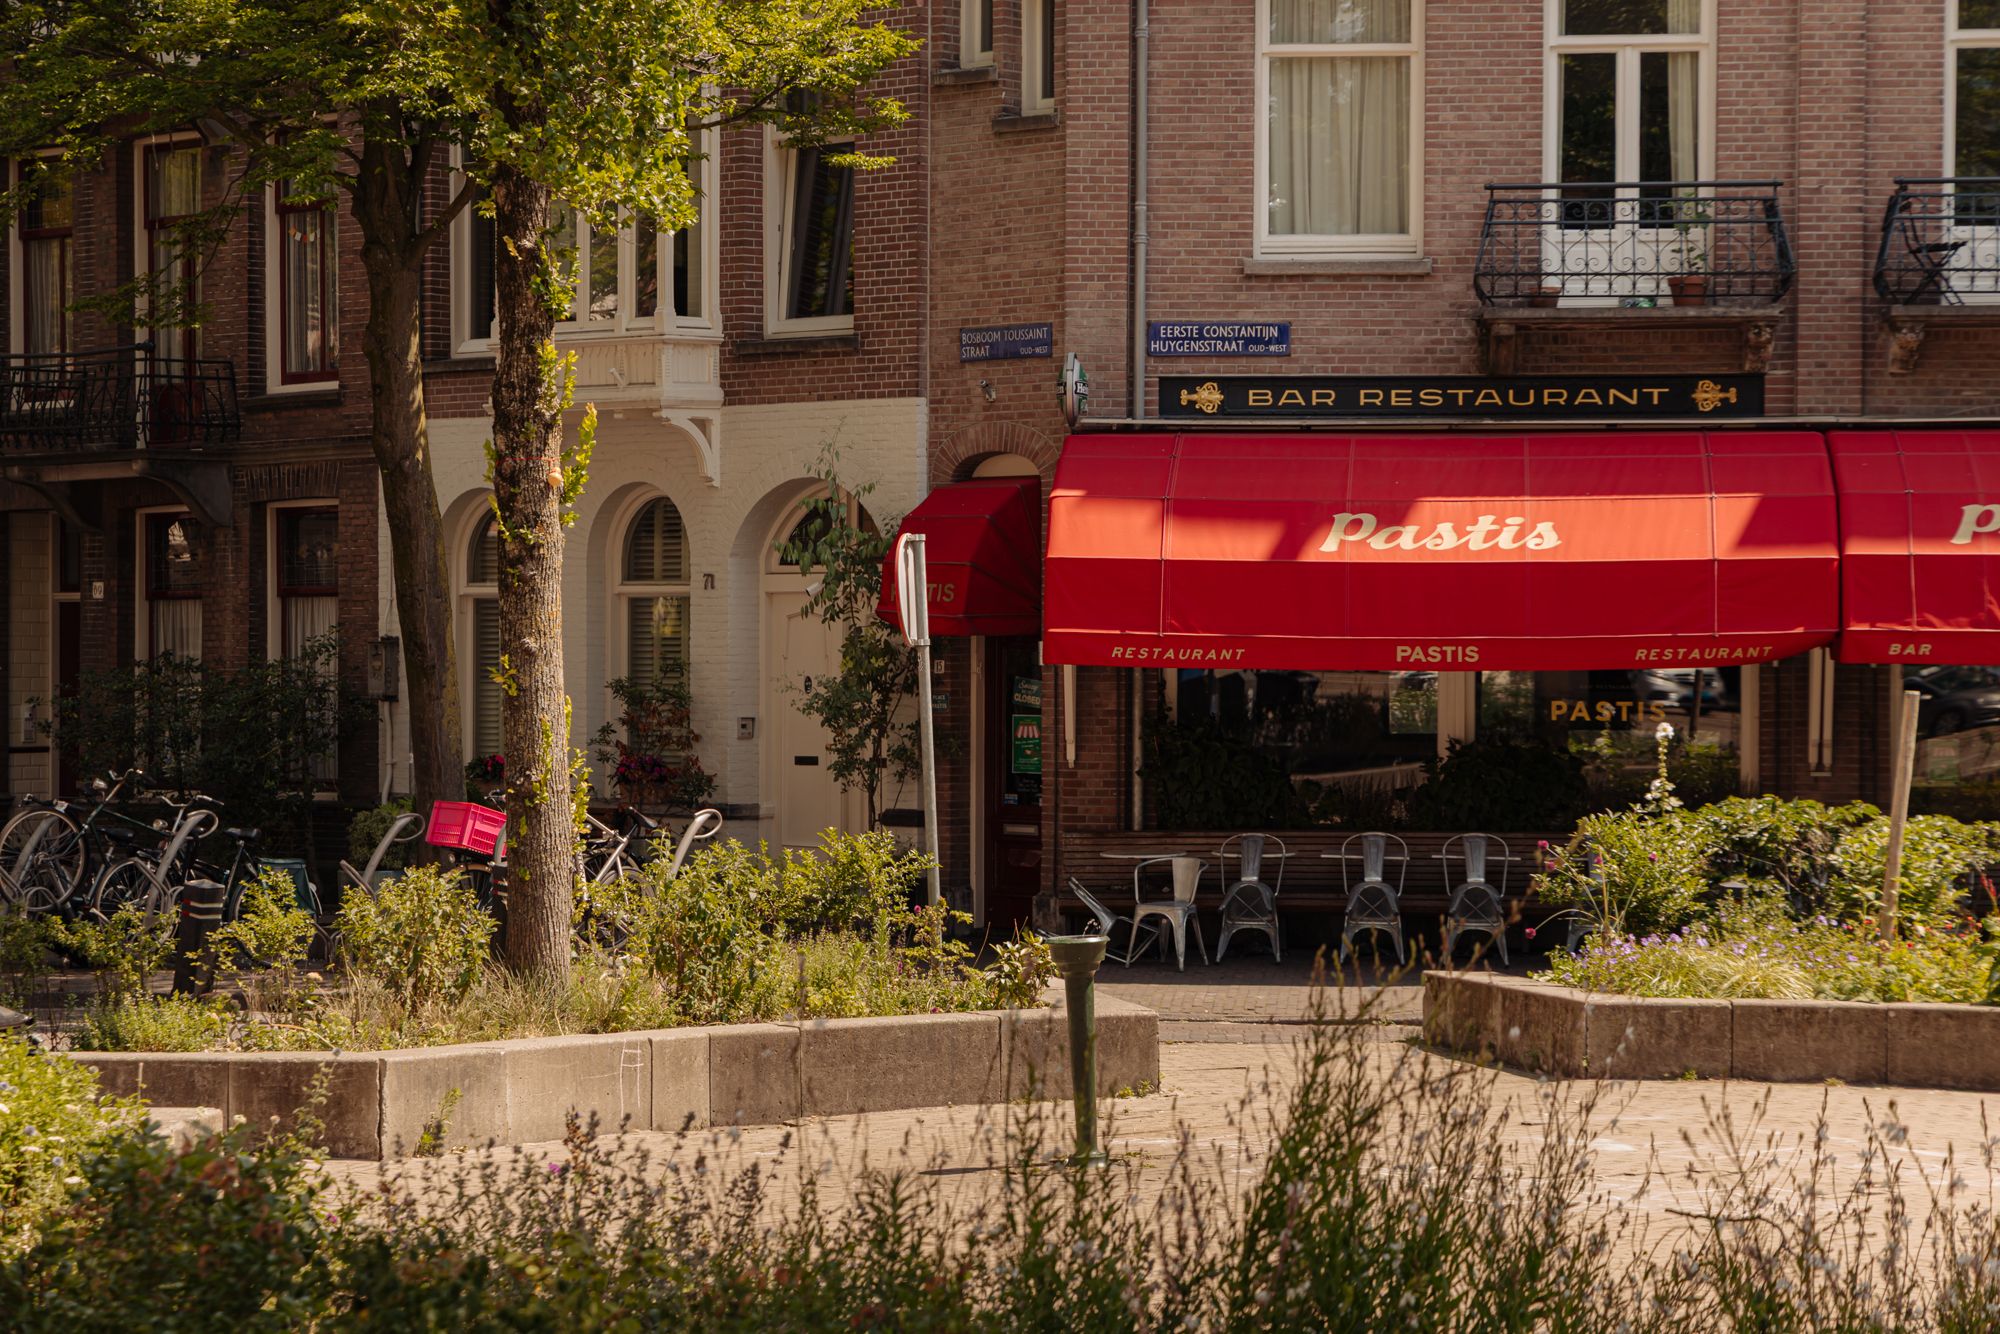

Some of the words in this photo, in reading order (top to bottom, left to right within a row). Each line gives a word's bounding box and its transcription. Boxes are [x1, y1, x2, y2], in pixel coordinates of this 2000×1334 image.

[962, 330, 1000, 344] BOSBOOM
[1003, 327, 1048, 341] TOUSSAINT
[1160, 325, 1199, 338] EERSTE
[1203, 325, 1278, 341] CONSTANTIJN
[962, 345, 990, 358] STRAAT
[1020, 346, 1048, 354] OUD-WEST
[1151, 340, 1244, 352] HUYGENSSTRAAT
[1248, 344, 1287, 352] OUD-WEST
[1248, 389, 1336, 406] BAR
[1359, 388, 1670, 406] RESTAURANT
[1318, 512, 1562, 552] Pastis
[703, 573, 715, 590] 71
[1111, 646, 1245, 661] RESTAURANT
[1395, 645, 1480, 663] PASTIS
[1635, 646, 1773, 661] RESTAURANT
[1887, 643, 1932, 655] BAR
[1014, 693, 1041, 705] CLOSED
[1550, 700, 1666, 721] PASTIS
